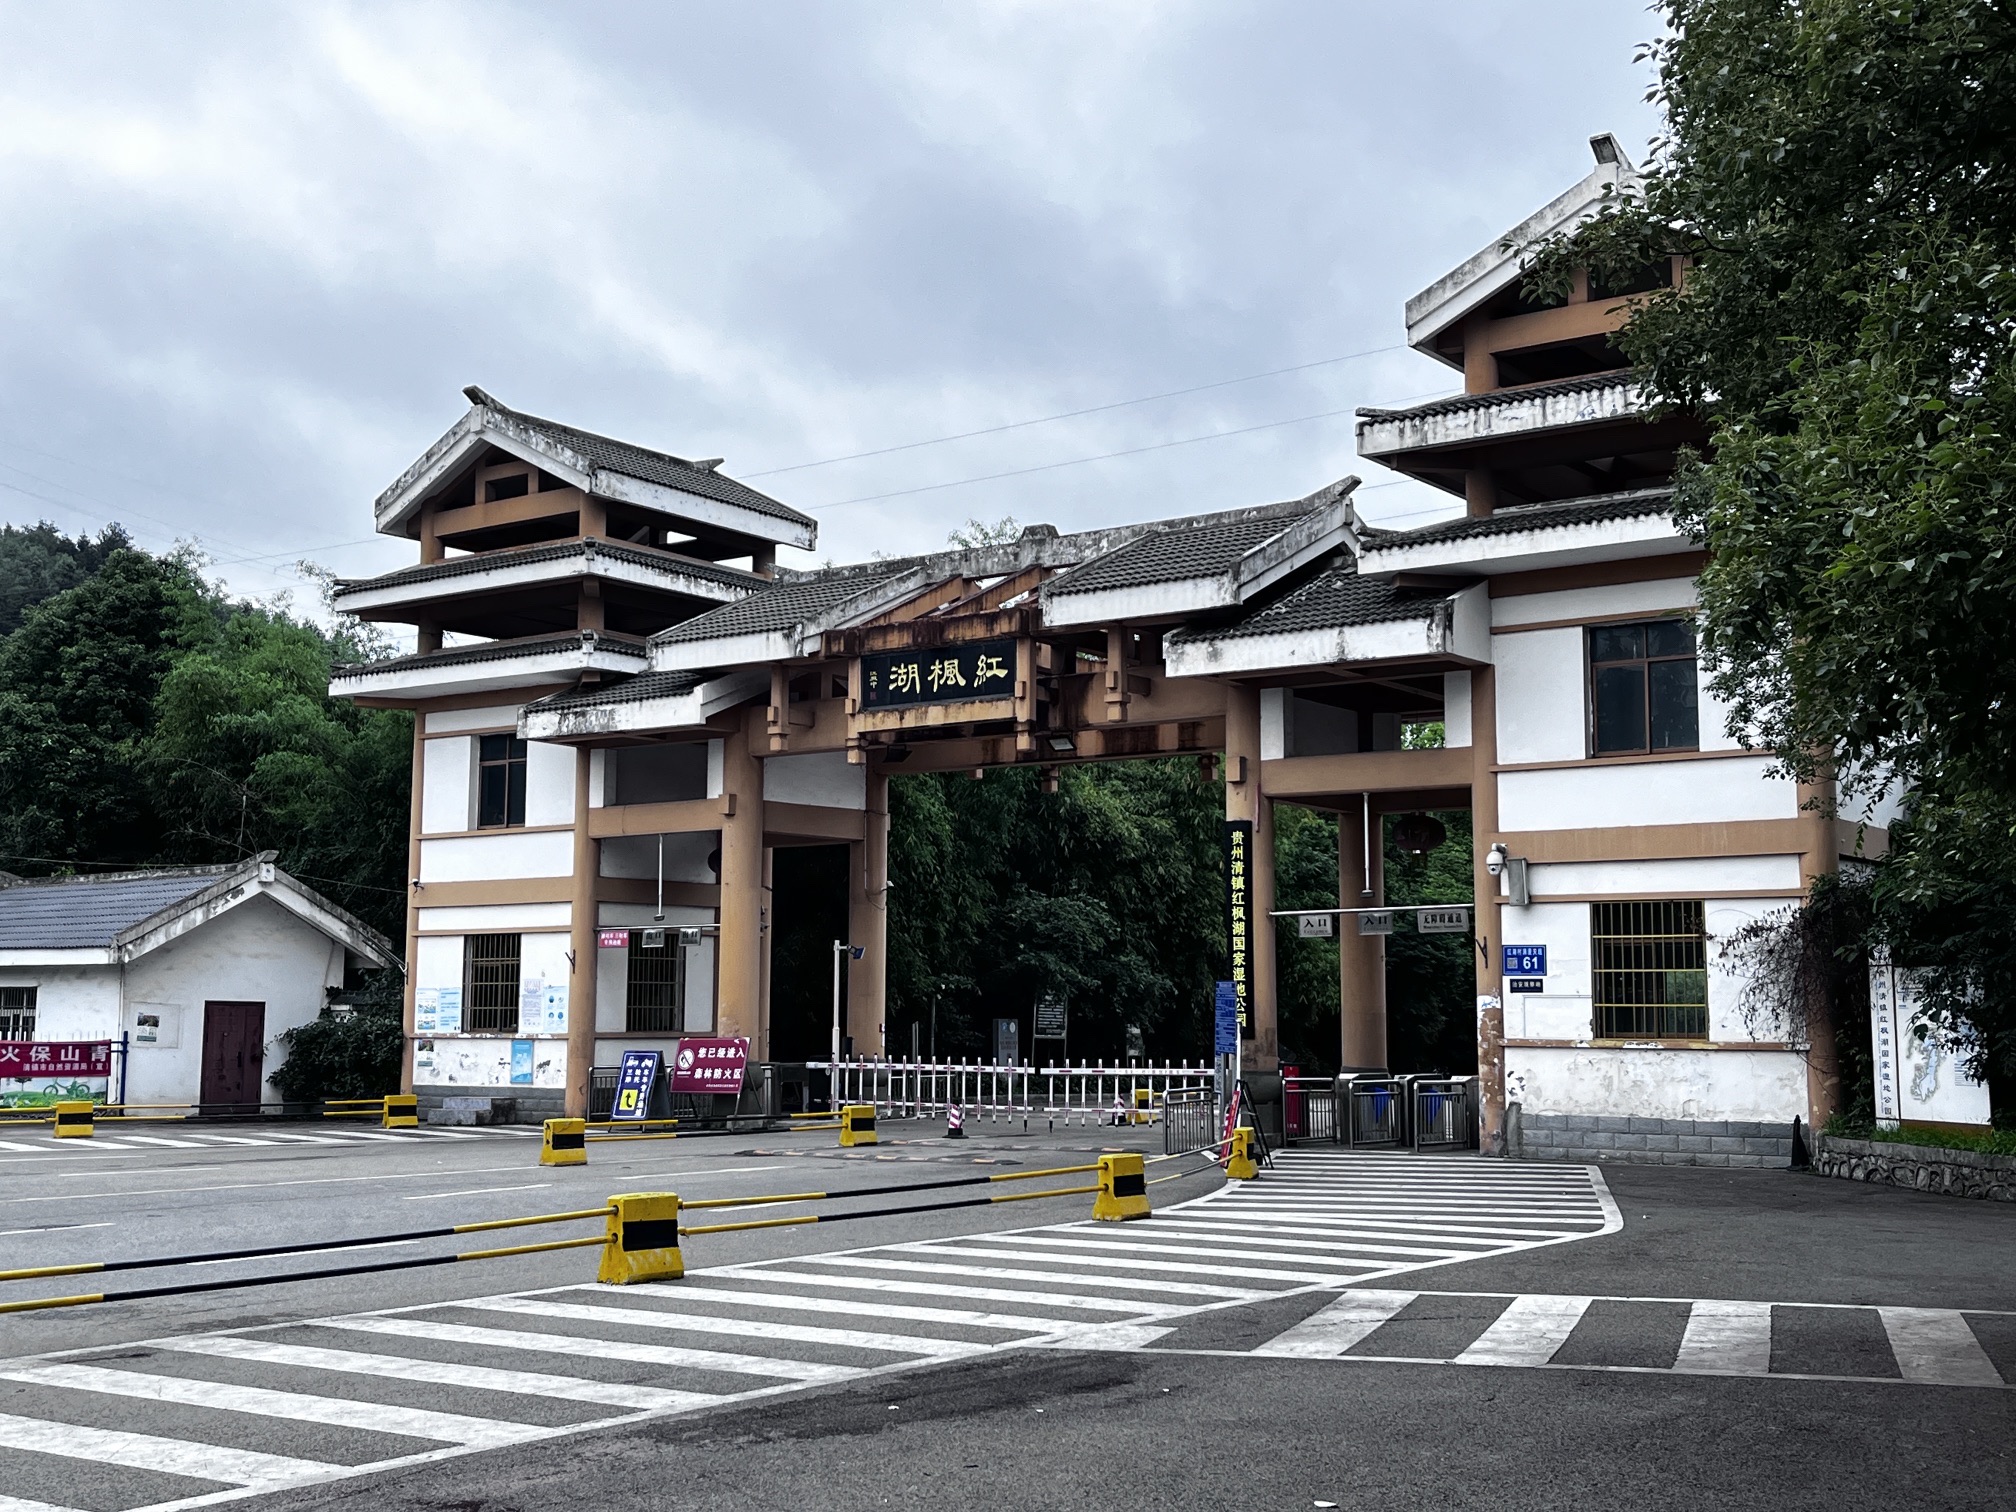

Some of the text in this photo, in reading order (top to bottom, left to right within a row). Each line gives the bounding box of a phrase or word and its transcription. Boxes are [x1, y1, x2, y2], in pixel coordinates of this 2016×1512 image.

[1304, 918, 1327, 928] 入口
[1364, 915, 1388, 925] 入口
[1522, 956, 1538, 970] 61
[697, 1046, 745, 1059] 您已经进入
[693, 1067, 742, 1080] 森林防火区
